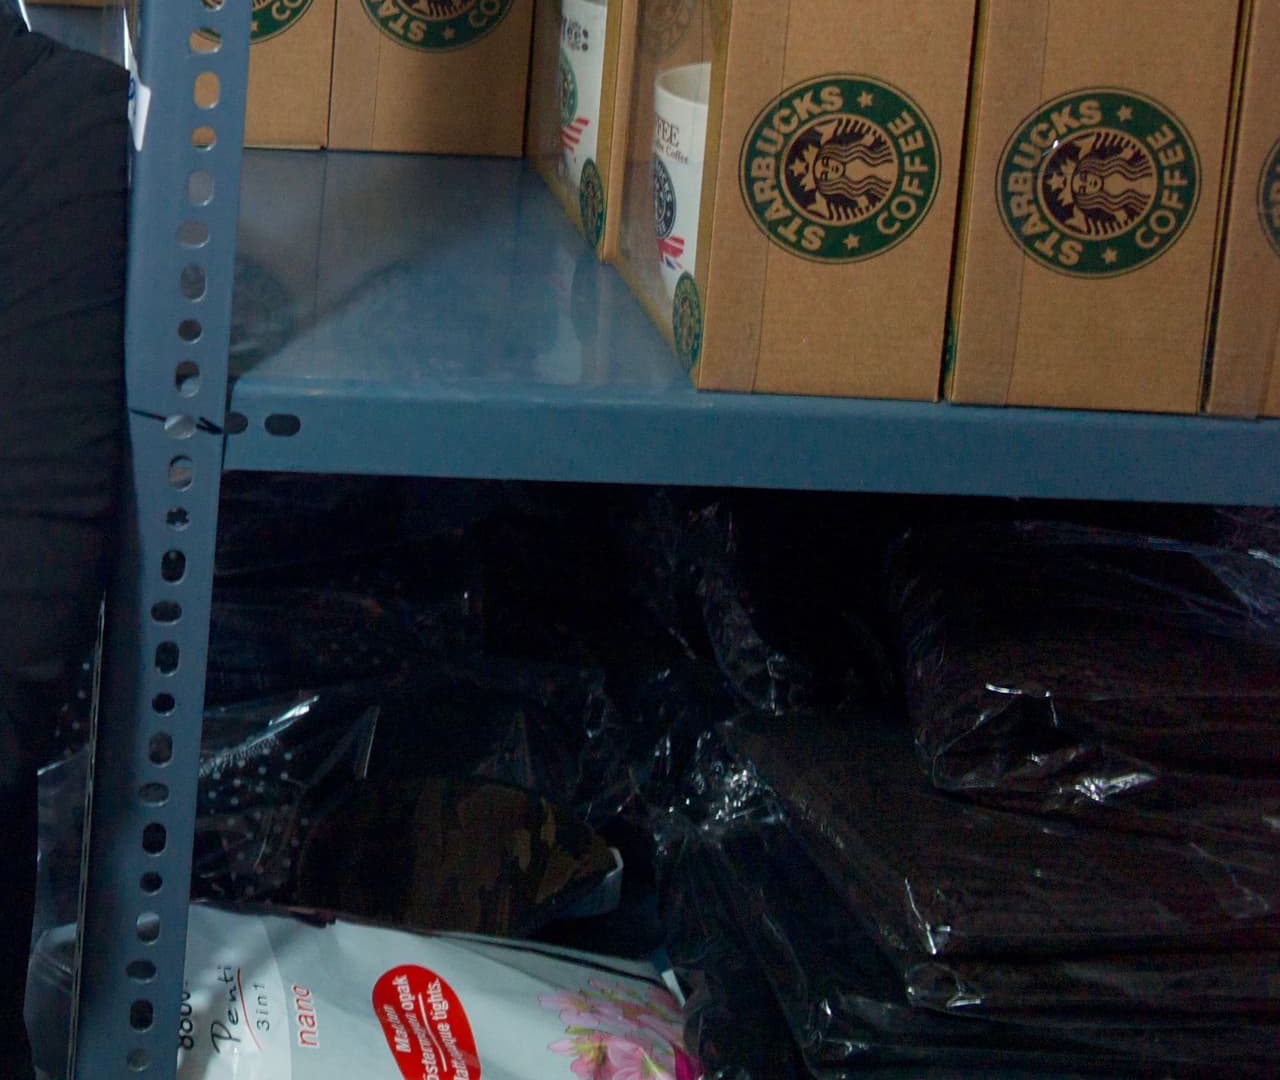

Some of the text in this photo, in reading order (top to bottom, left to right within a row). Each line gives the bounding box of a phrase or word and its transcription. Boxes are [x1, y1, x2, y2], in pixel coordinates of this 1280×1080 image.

[750, 85, 843, 251] STARBUCKS
[876, 110, 929, 235] COFFEE
[1007, 99, 1103, 266] STARBUCKS
[1135, 123, 1189, 249] COFFEE
[210, 965, 242, 1054] Penti
[292, 983, 318, 1047] nano
[392, 973, 416, 1011] opak
